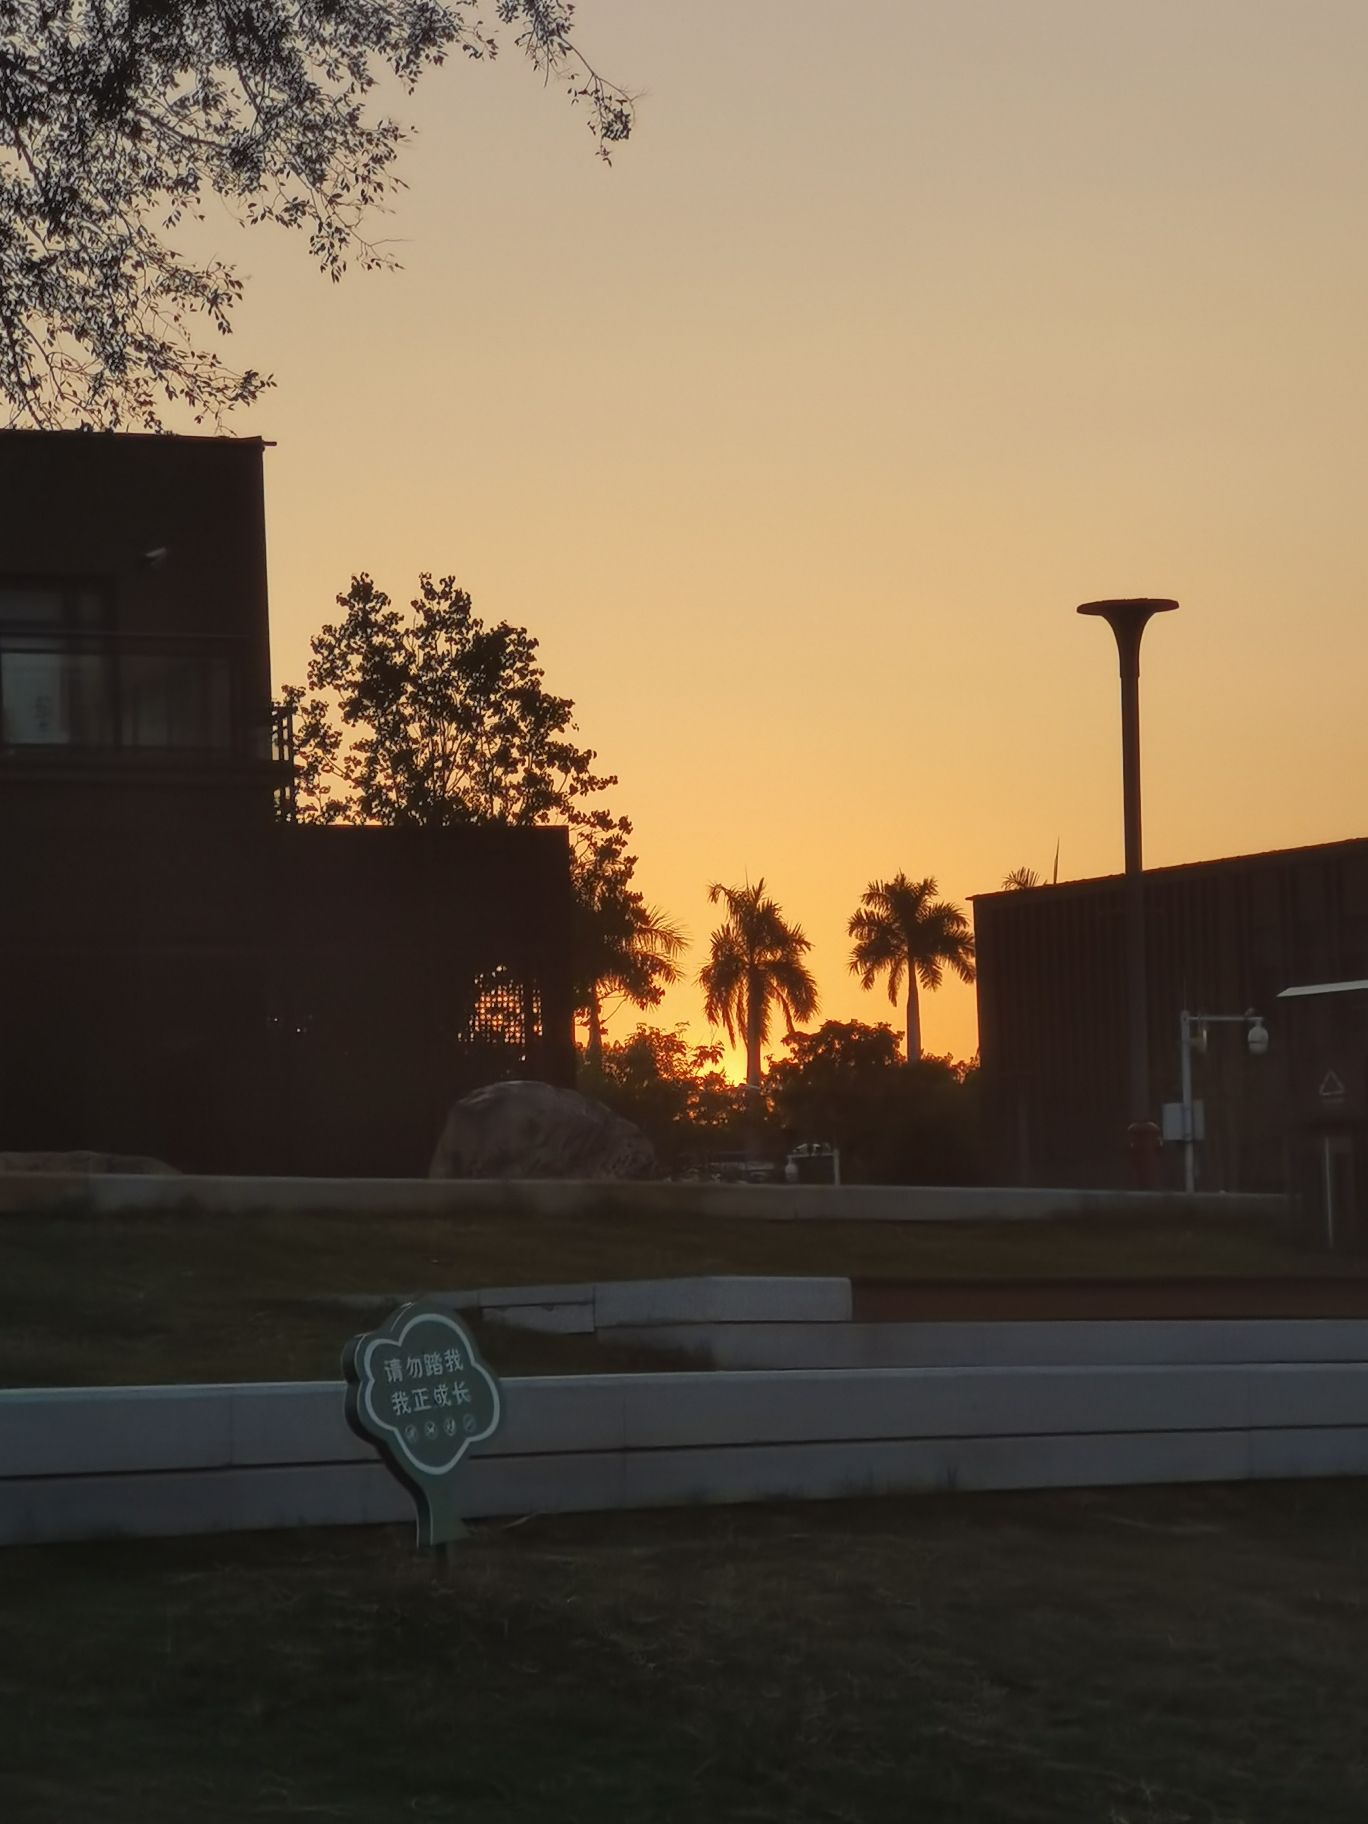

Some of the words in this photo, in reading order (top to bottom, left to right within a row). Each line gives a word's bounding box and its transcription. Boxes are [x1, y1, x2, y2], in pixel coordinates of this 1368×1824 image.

[384, 1348, 464, 1383] 请勿踏我
[391, 1381, 471, 1416] 我正成长
